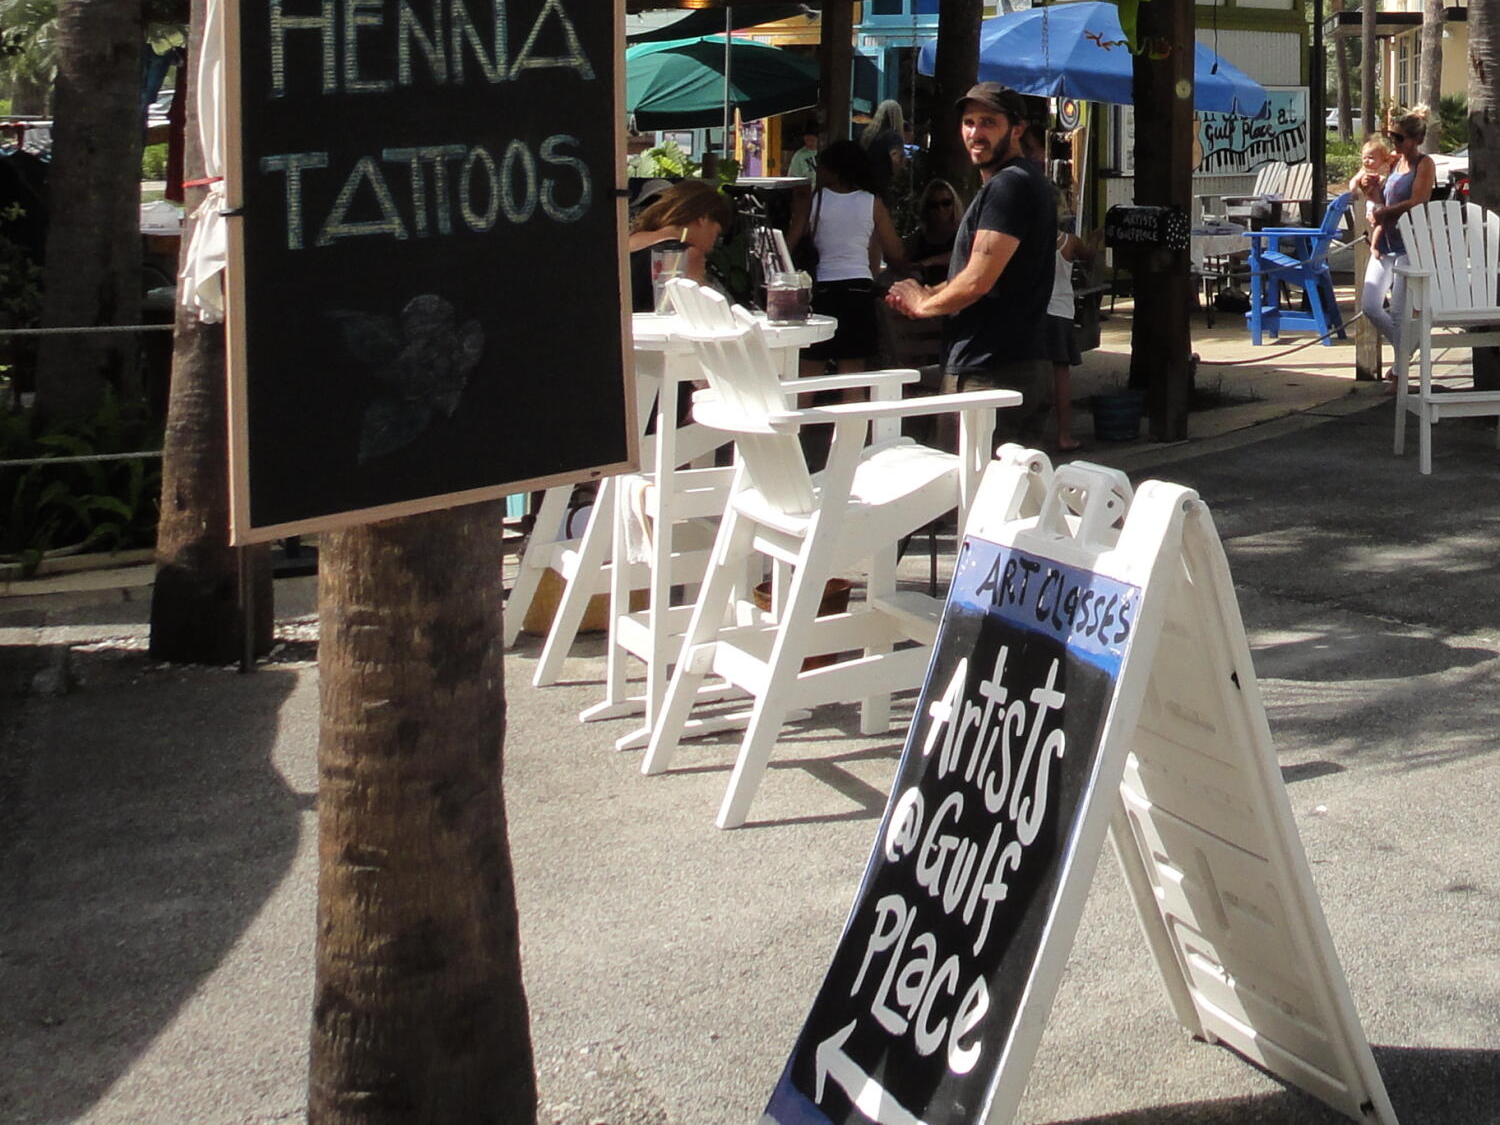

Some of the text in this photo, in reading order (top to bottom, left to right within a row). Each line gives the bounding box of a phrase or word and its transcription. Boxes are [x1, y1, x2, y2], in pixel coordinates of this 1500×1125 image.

[258, 133, 593, 250] TATTOOS
[975, 551, 1041, 607] ART
[924, 644, 1066, 848] Artists
